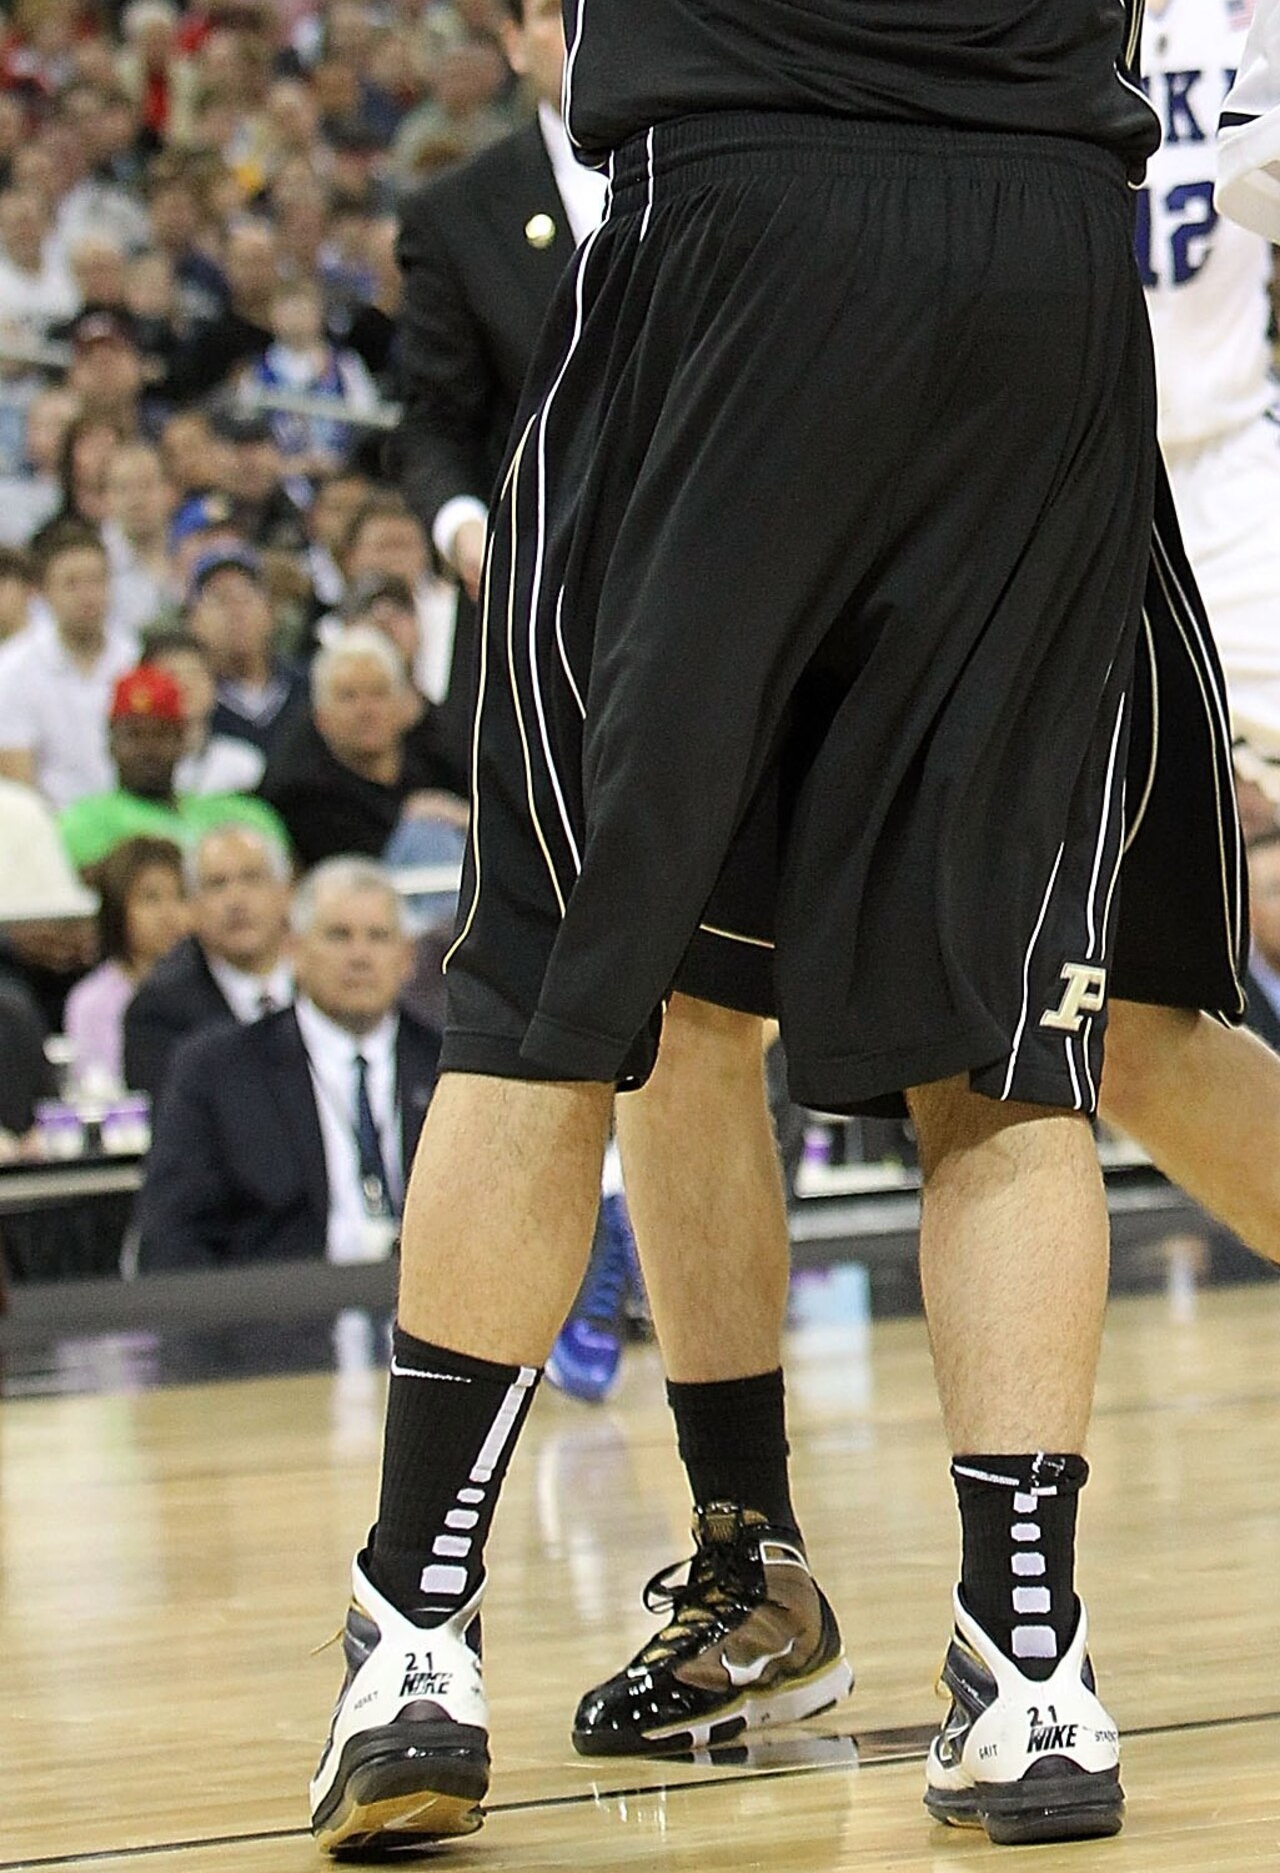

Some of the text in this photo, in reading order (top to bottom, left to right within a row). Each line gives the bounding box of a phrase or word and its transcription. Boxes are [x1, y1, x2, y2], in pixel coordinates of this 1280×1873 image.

[404, 1651, 433, 1672] 21
[1026, 1704, 1058, 1728] 21
[1026, 1723, 1079, 1754] NIKE
